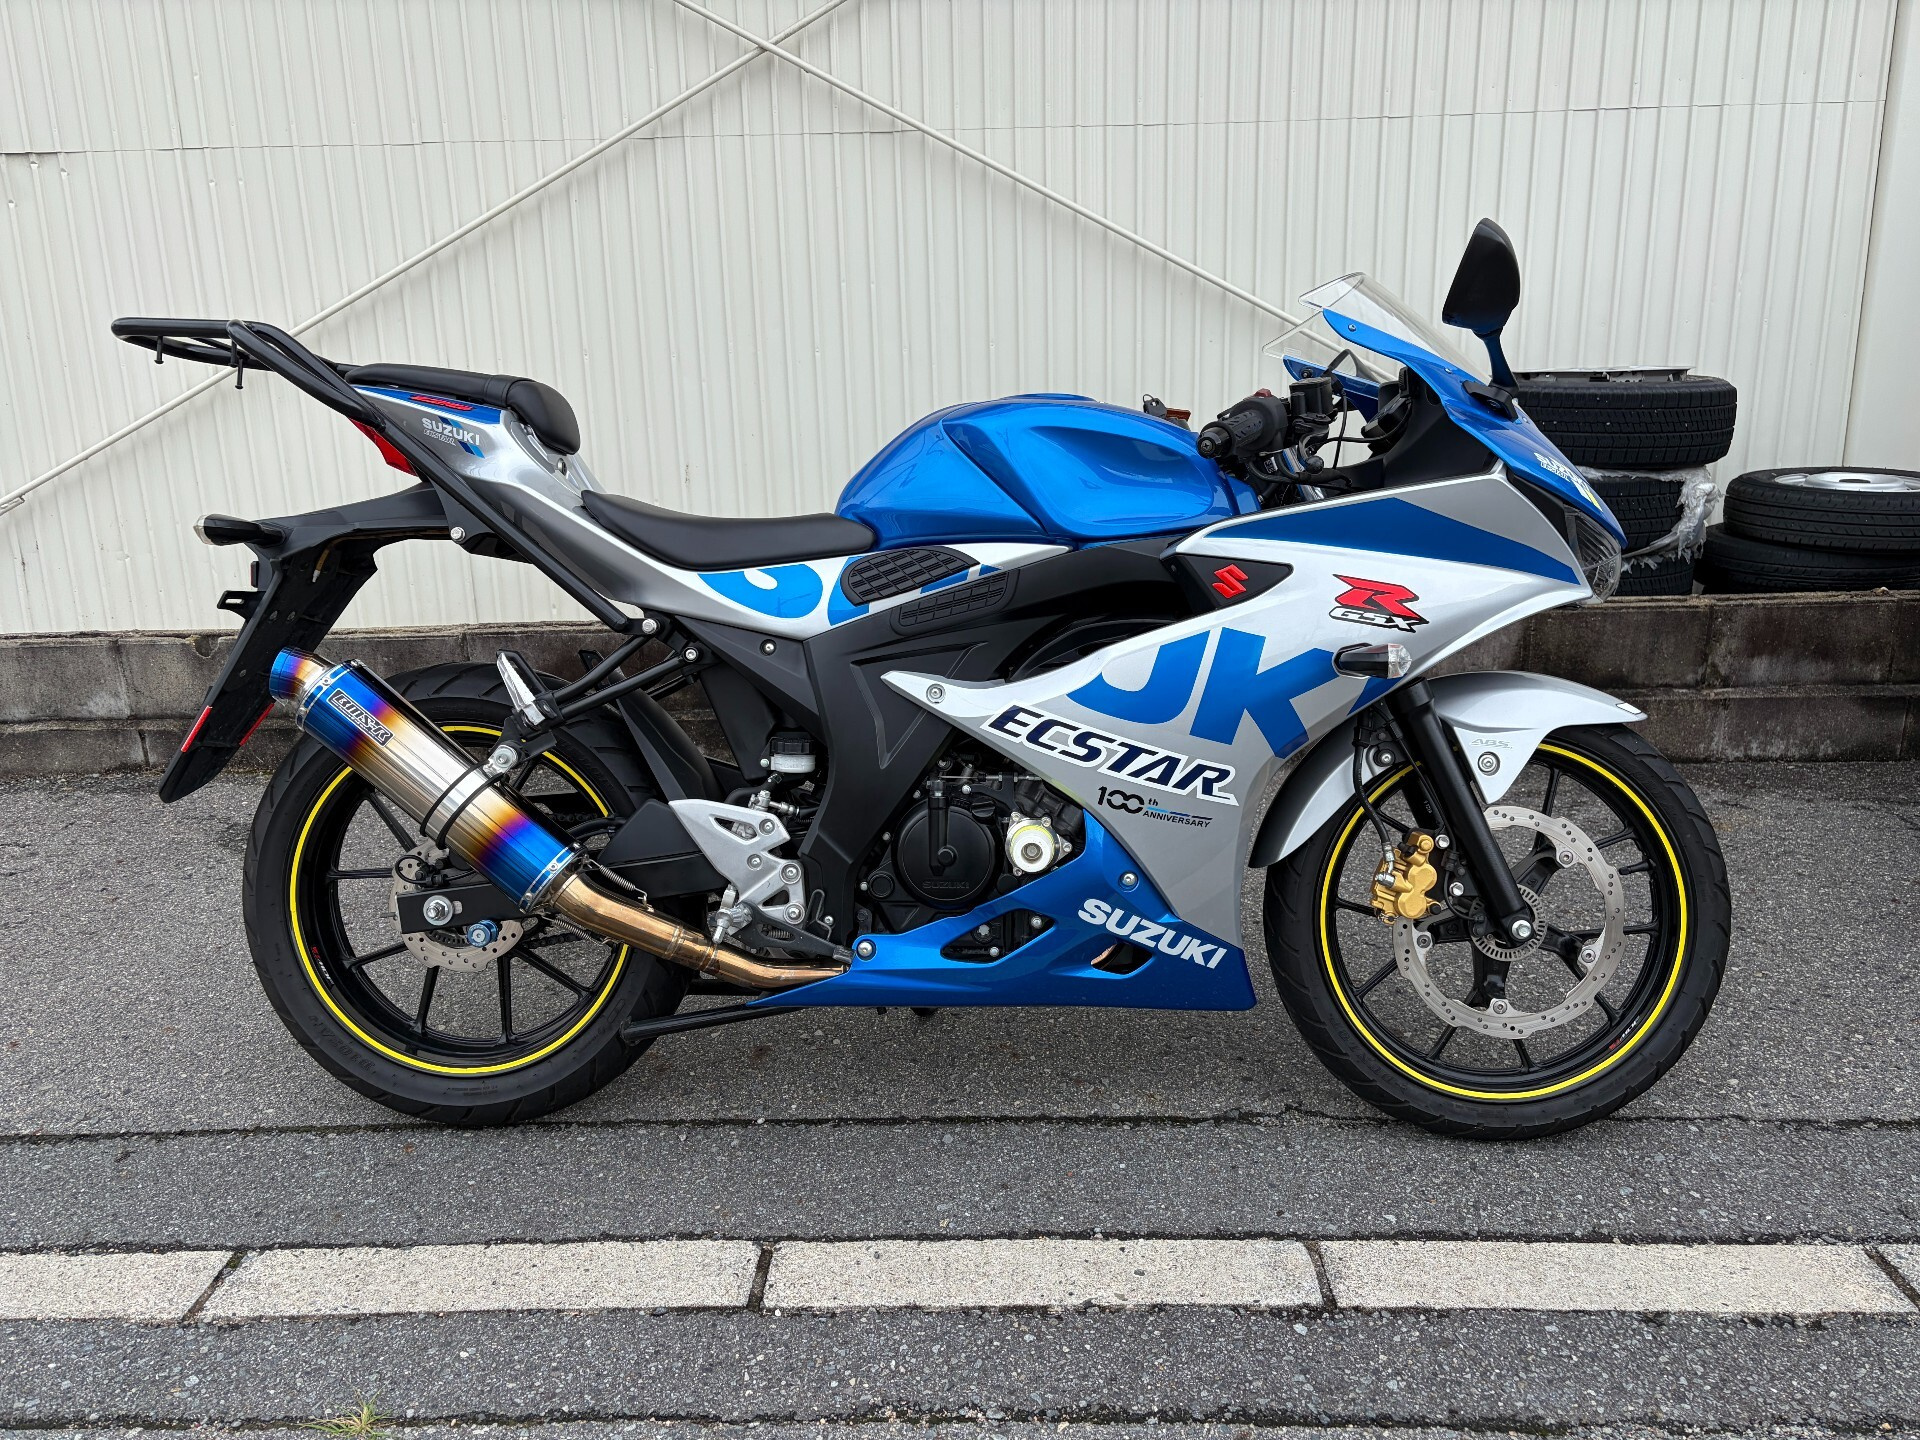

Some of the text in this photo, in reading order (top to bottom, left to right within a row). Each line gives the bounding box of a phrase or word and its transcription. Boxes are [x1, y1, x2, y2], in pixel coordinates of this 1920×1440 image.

[422, 417, 480, 446] SUZUKI
[1329, 606, 1420, 633] GSX
[983, 703, 1237, 803] ECSTAR
[1471, 738, 1511, 749] ABS
[1143, 810, 1211, 829] ANNIVERSARY
[923, 881, 970, 889] SUZUKI
[1078, 899, 1228, 970] SUZUKI
